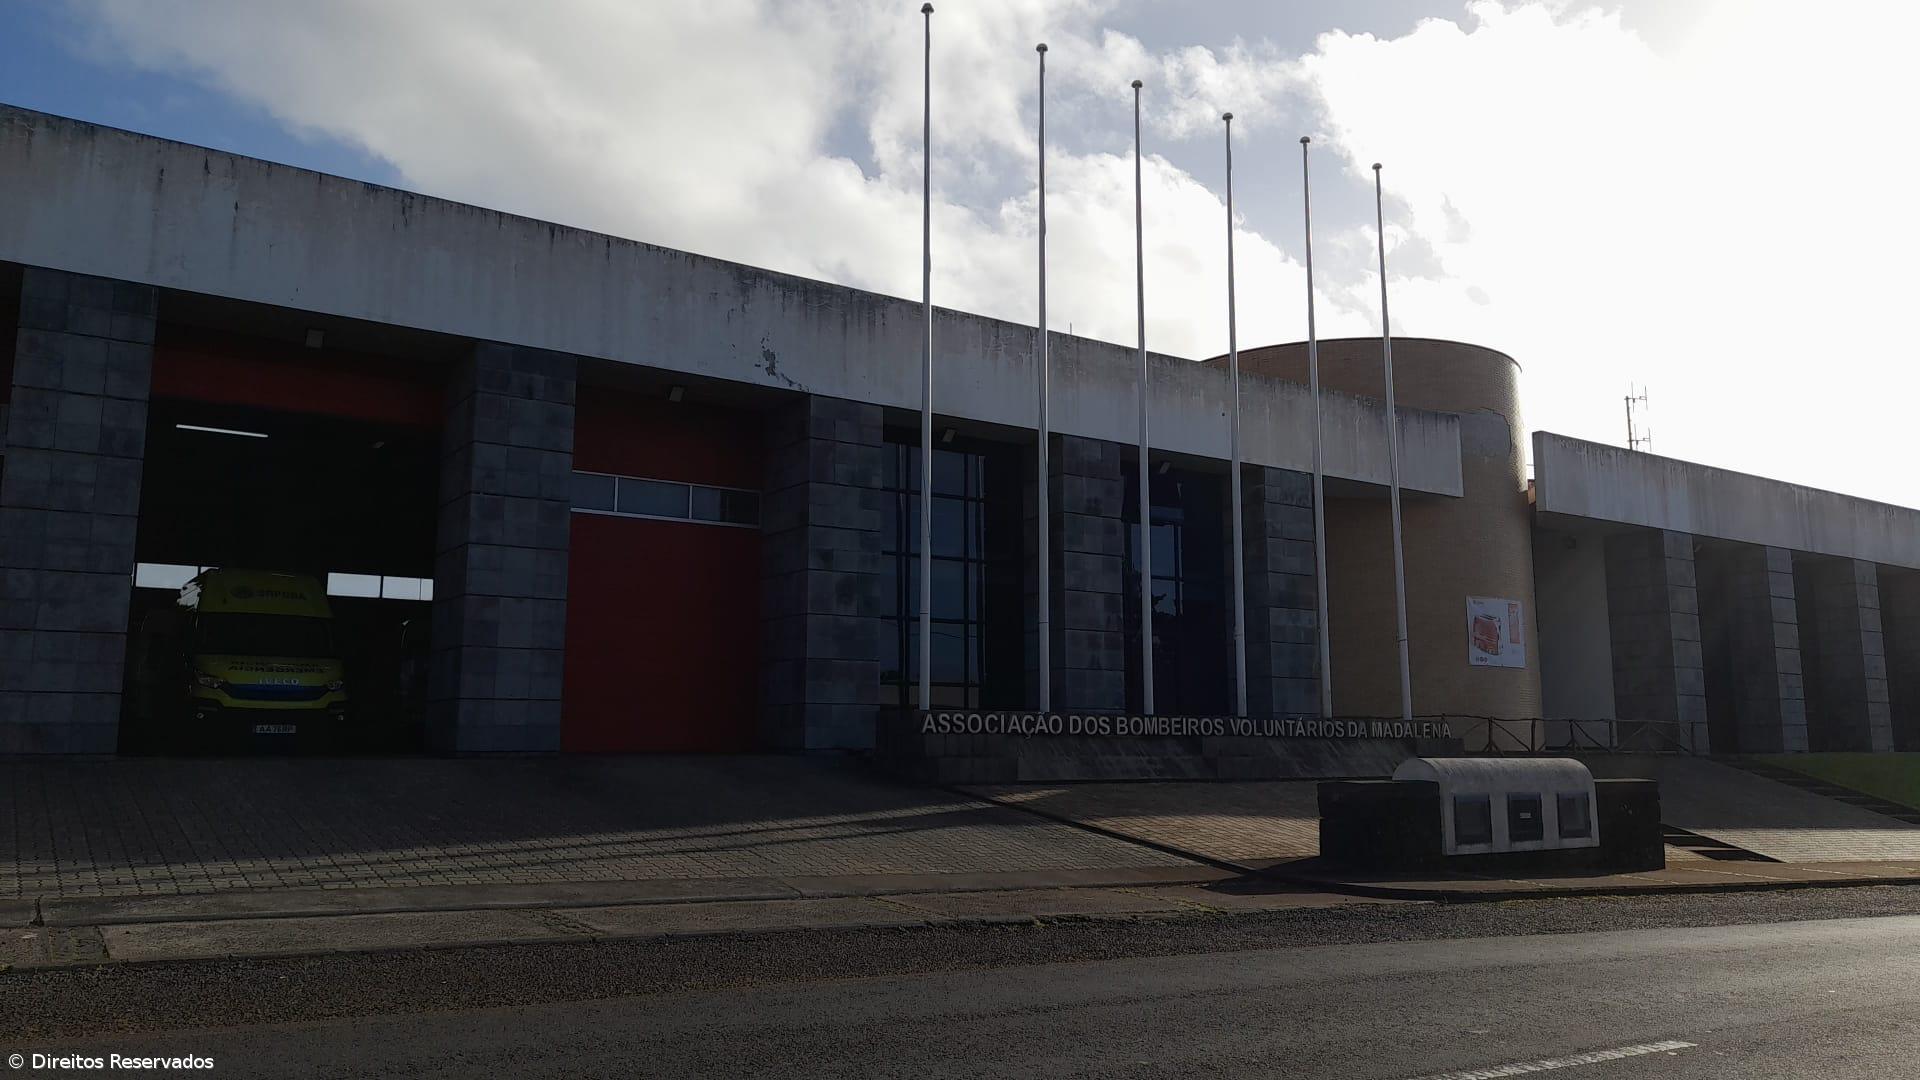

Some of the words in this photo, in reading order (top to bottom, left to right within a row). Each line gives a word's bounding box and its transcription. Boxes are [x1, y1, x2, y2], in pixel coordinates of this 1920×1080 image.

[258, 677, 300, 686] IVECO
[921, 712, 1063, 739] ASSOCIAÇÃO
[1069, 715, 1110, 736] DOS
[1116, 716, 1225, 737] BOMBEIROS
[1230, 717, 1344, 738] VOLUNTÁRIOS
[1348, 721, 1368, 739] DA
[1372, 721, 1452, 739] MADALENA
